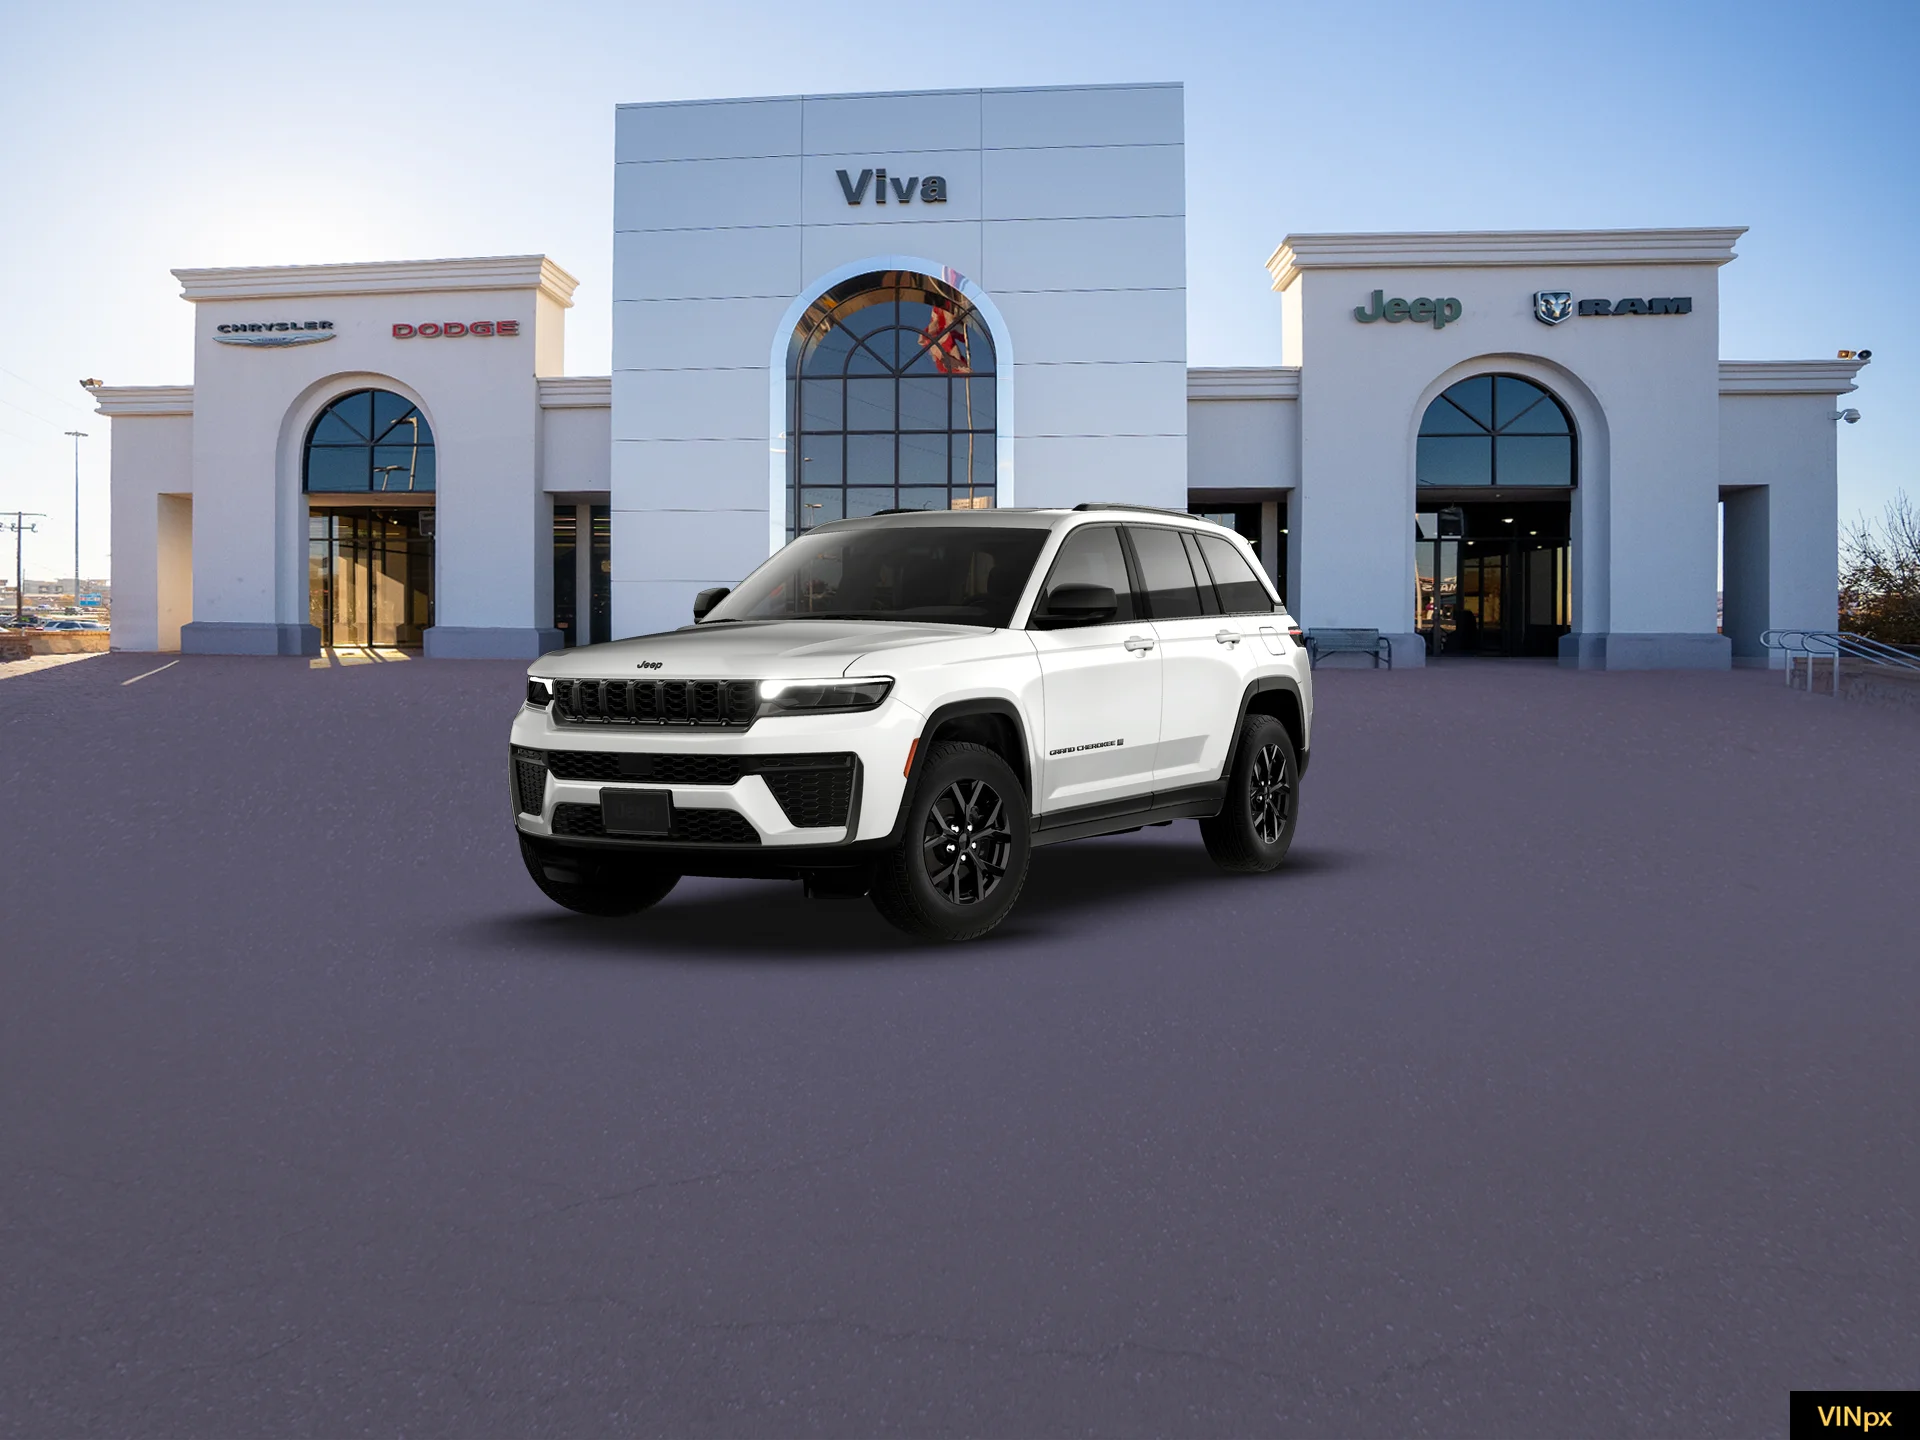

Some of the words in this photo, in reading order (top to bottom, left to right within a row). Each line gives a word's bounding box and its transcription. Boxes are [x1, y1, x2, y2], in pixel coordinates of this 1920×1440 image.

[835, 168, 947, 205] Viva
[1353, 289, 1462, 330] Jeep
[1578, 297, 1692, 316] RAM
[217, 321, 334, 333] CHRYSLER
[392, 320, 520, 339] DODGE
[636, 660, 663, 670] Jeep
[1049, 746, 1076, 756] GRAND
[1076, 740, 1116, 752] CHEROKEE
